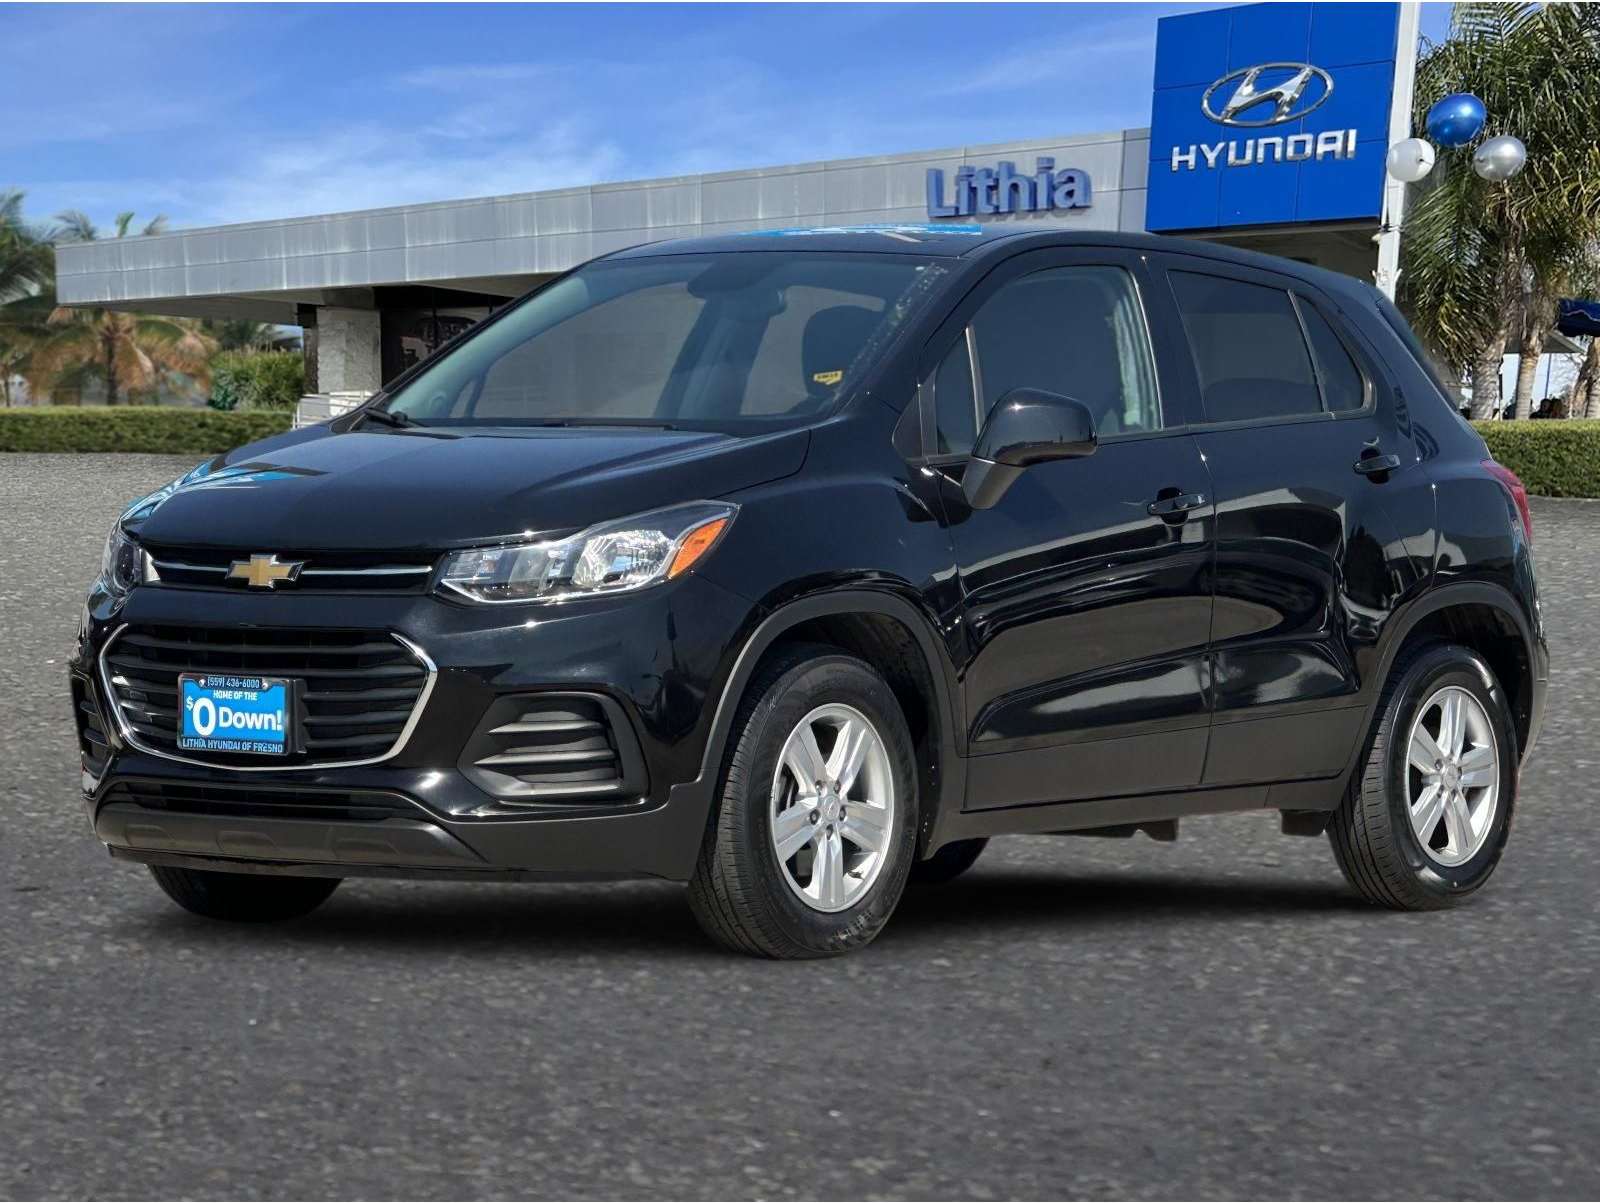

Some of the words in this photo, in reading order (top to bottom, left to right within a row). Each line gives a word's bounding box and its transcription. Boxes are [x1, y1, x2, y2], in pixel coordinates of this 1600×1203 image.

[1171, 129, 1357, 171] HYUNDAI
[926, 157, 1092, 217] Lithia
[207, 676, 225, 687] (559)
[226, 678, 260, 689] 436-6000
[213, 690, 233, 699] HOME
[233, 691, 243, 700] OF
[244, 691, 258, 701] THE
[218, 707, 283, 731] Down!
[182, 738, 207, 748] LITHIA
[207, 740, 241, 750] HYUNDAI
[241, 742, 252, 751] OF
[253, 743, 283, 753] FRESNO
